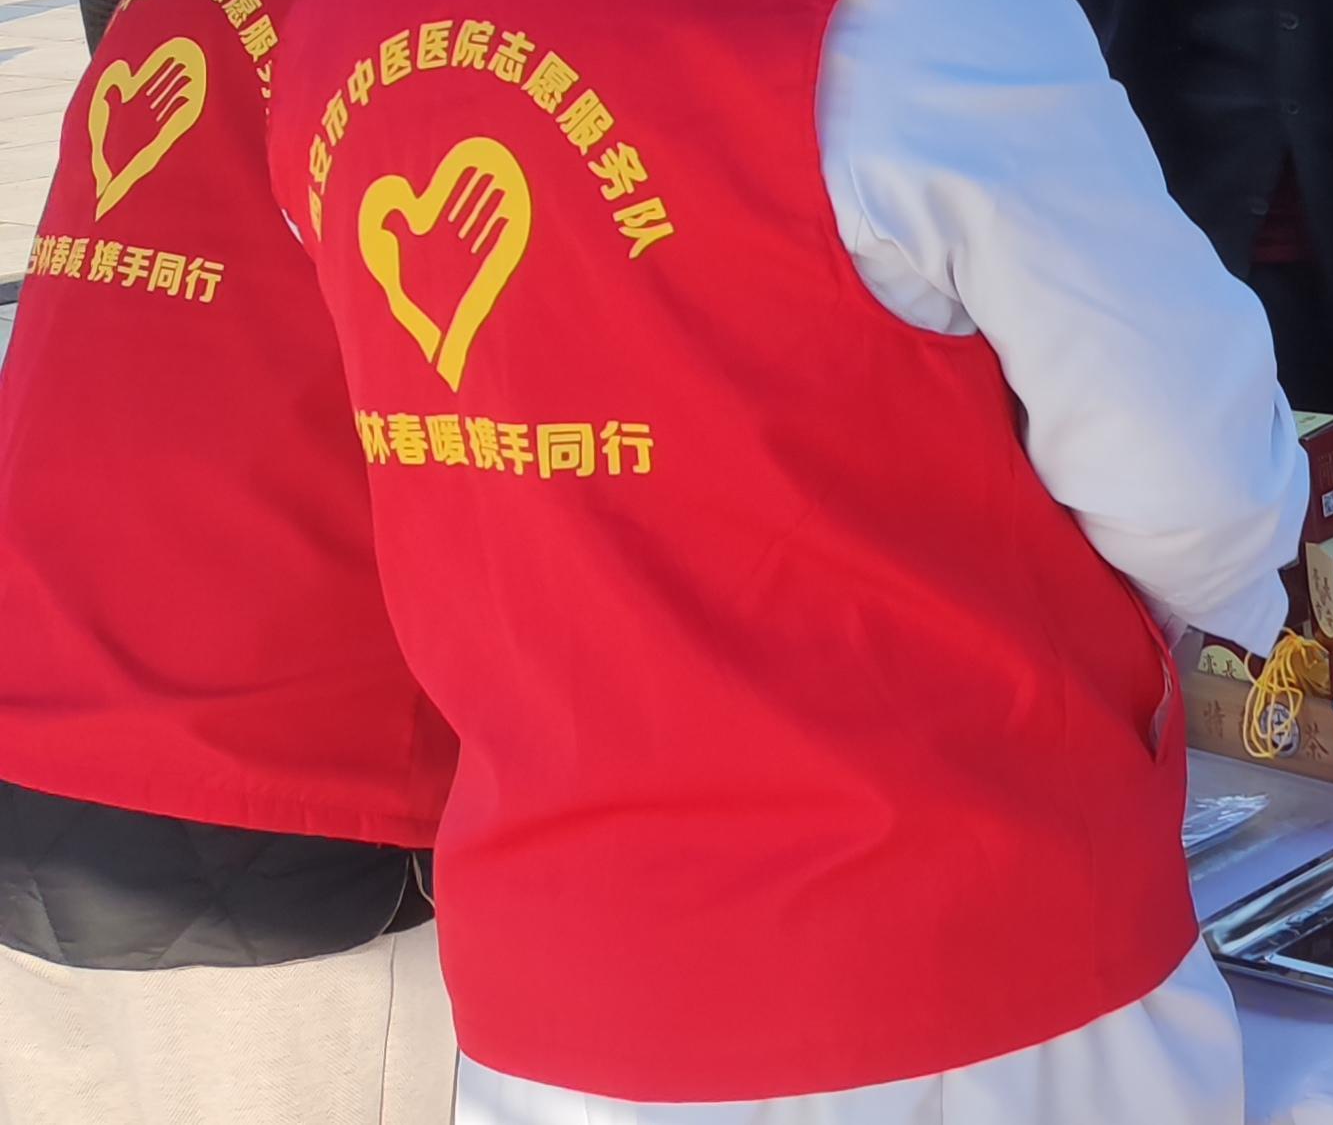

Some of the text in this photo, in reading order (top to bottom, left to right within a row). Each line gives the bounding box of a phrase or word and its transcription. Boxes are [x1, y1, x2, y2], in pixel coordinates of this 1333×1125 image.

[307, 19, 675, 259] 西安市中医医院志愿服务队
